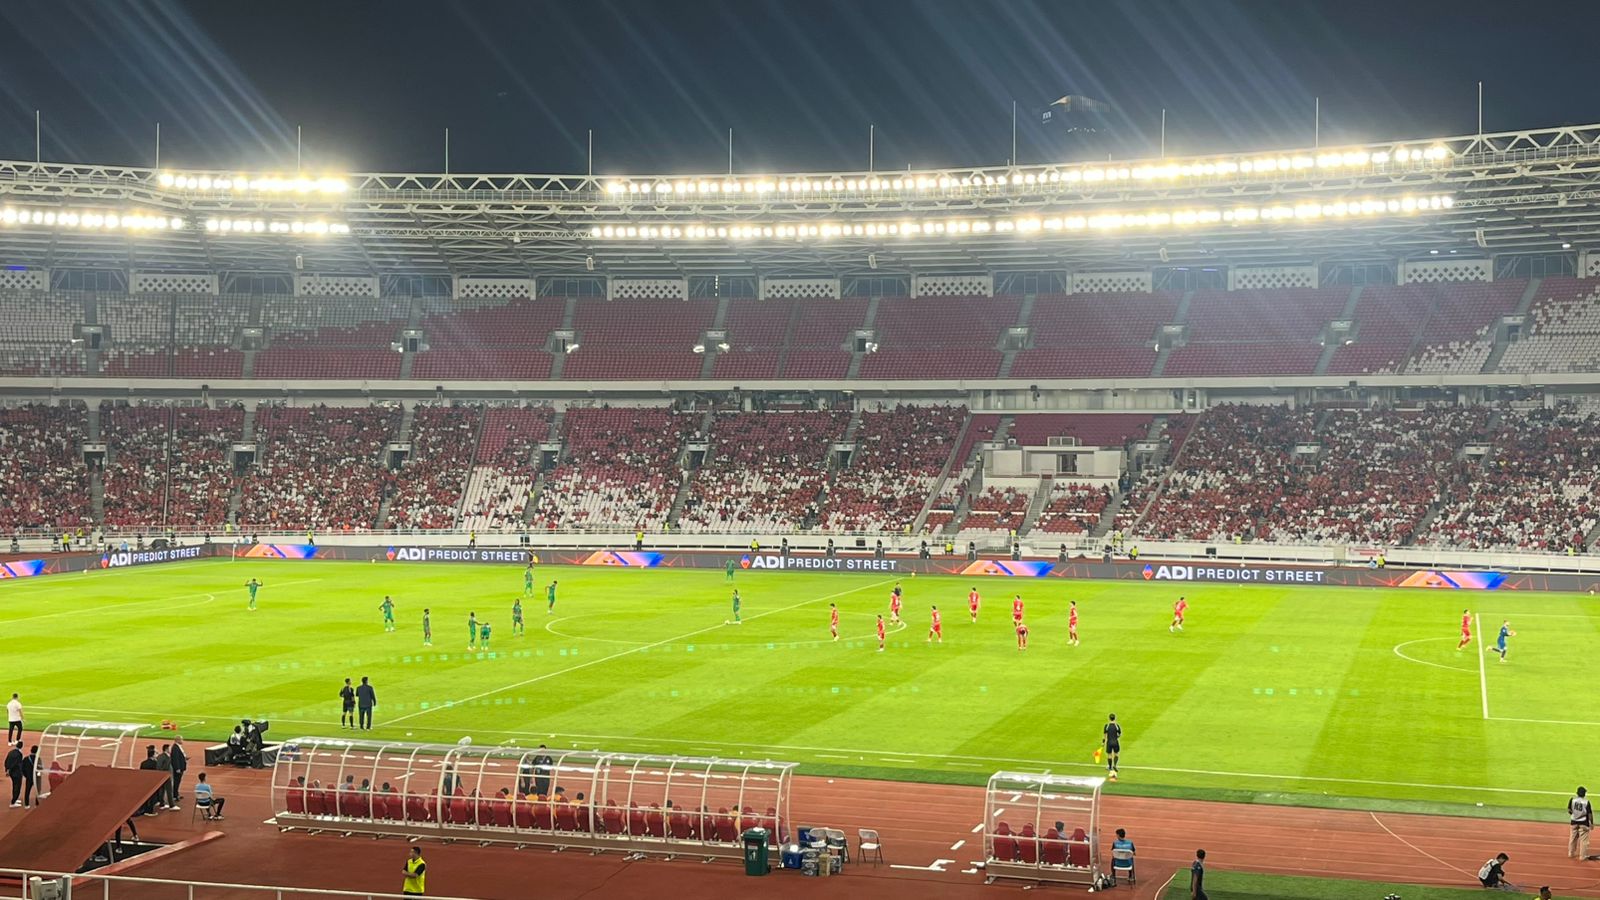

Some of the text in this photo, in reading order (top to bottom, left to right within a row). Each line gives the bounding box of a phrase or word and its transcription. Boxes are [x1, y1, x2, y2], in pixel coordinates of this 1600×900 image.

[109, 547, 201, 567] ADI PREDICT STREET
[396, 548, 526, 560] ADI PREDICT STREET
[752, 556, 896, 570] ADI PREDICT STREET
[1156, 566, 1324, 582] ADI PREDICT STREET
